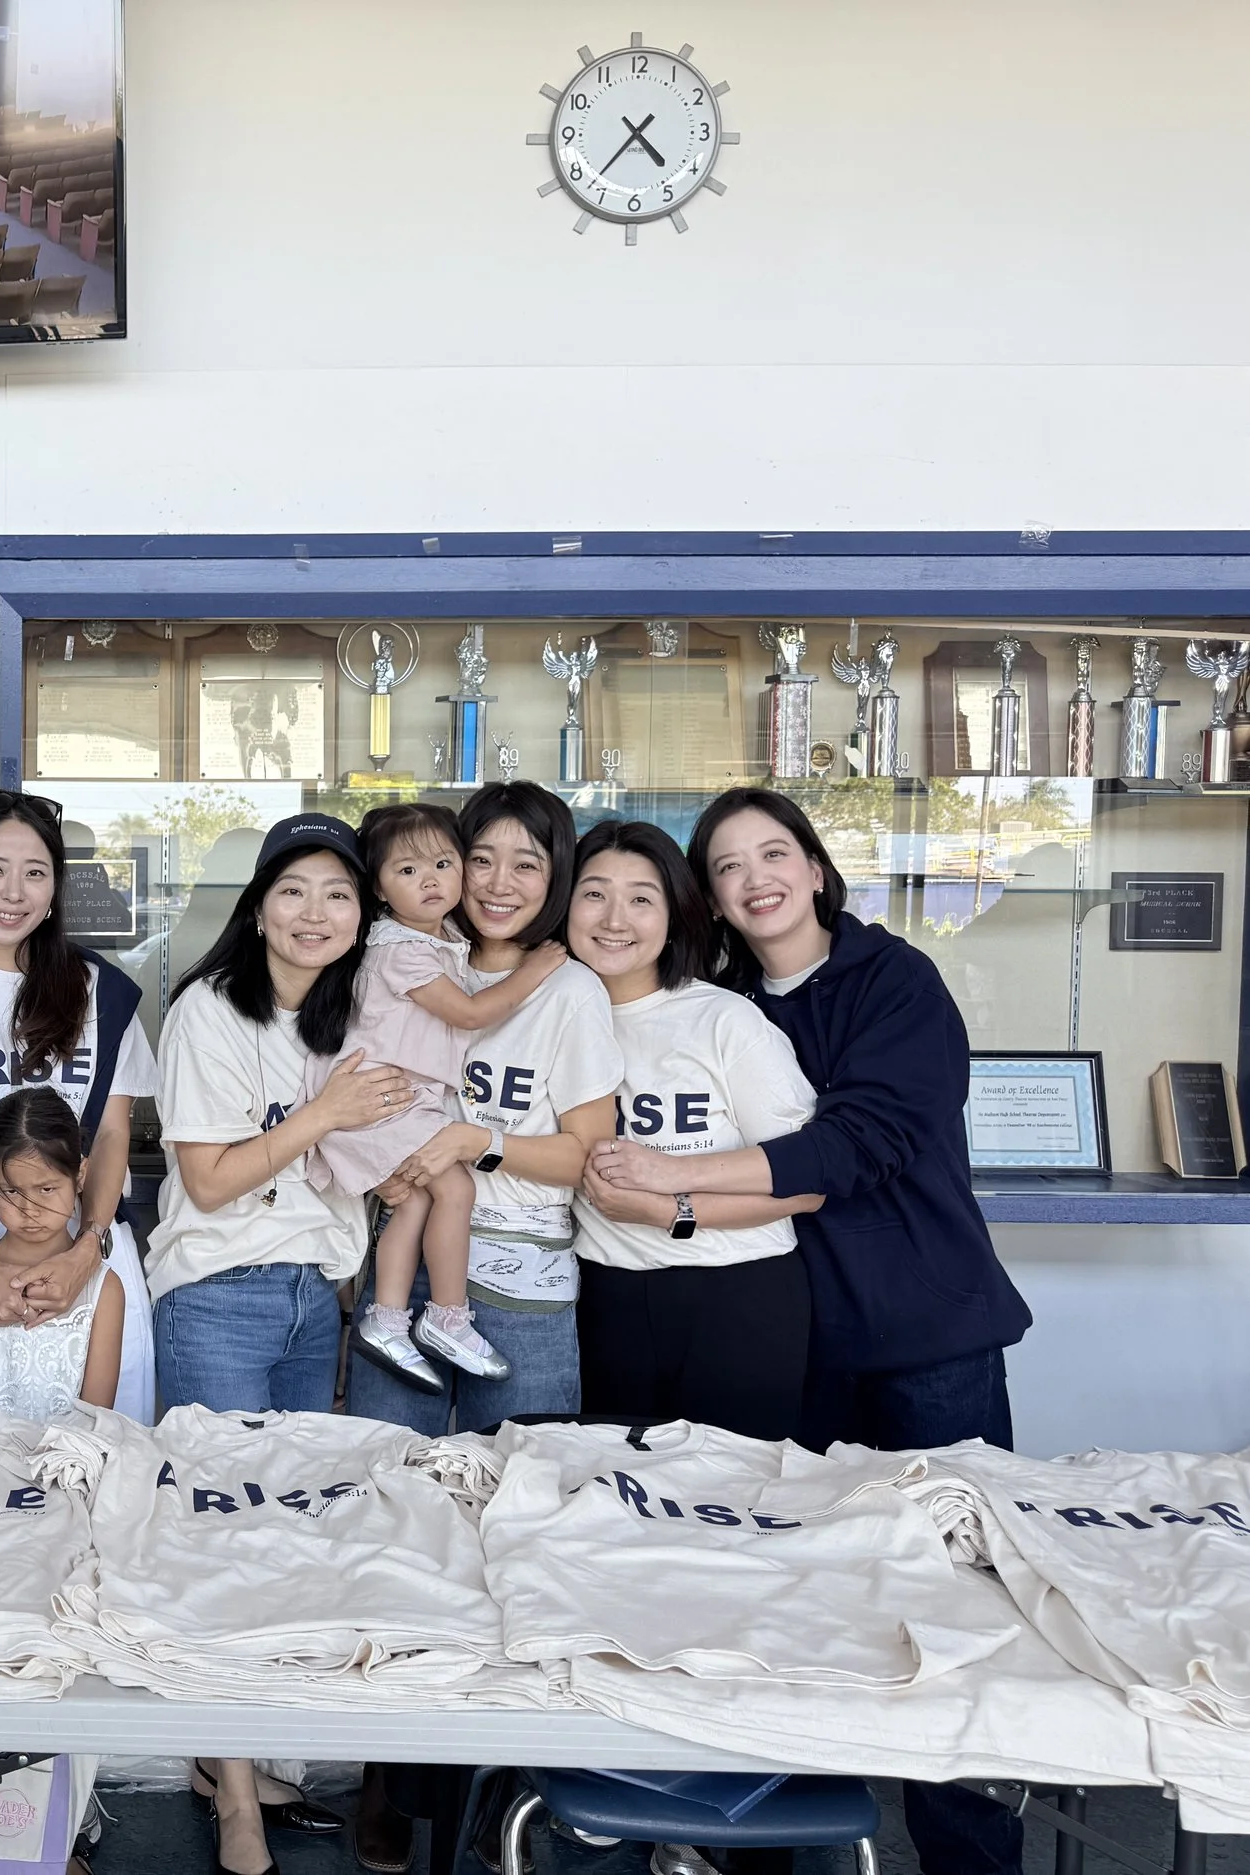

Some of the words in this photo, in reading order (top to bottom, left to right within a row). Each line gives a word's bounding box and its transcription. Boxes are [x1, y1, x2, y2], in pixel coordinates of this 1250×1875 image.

[631, 56, 648, 73] 12
[598, 66, 610, 83] 11
[672, 65, 676, 83] 1
[570, 94, 588, 110] 10
[693, 88, 704, 106] 2
[562, 126, 576, 145] 9
[699, 123, 710, 141] 3
[570, 162, 583, 181] 8
[688, 156, 699, 175] 4
[596, 188, 607, 205] 7
[663, 185, 674, 202] 5
[627, 194, 641, 212] 6
[601, 748, 621, 767] 90
[1182, 753, 1202, 771] 89
[290, 824, 328, 834] Ephesians
[981, 1085, 1006, 1095] Award
[1008, 1087, 1018, 1095] of
[1019, 1085, 1060, 1095] Excellence
[693, 1139, 714, 1149] 5:14
